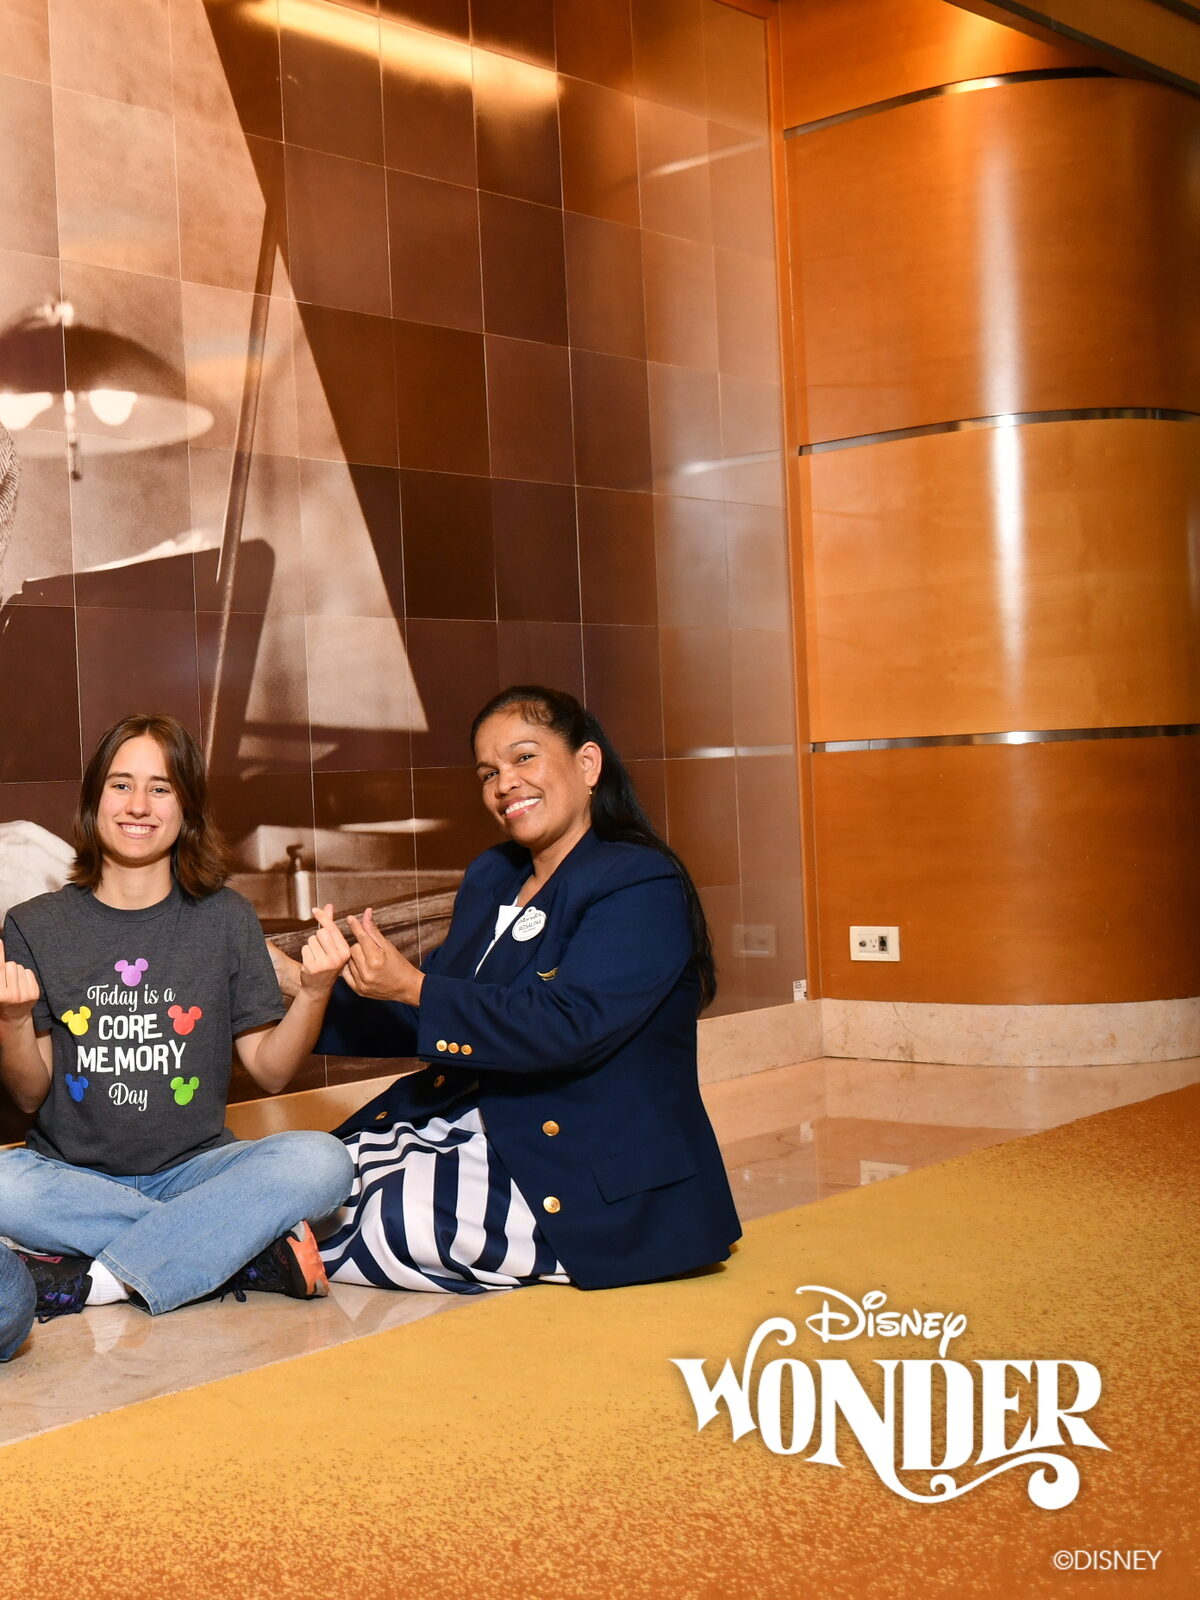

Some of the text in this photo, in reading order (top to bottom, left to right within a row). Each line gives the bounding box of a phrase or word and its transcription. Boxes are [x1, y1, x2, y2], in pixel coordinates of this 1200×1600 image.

[86, 983, 176, 1012] Today is a
[98, 1010, 163, 1043] CORE
[76, 1037, 187, 1076] MEMORY
[107, 1082, 149, 1112] Day
